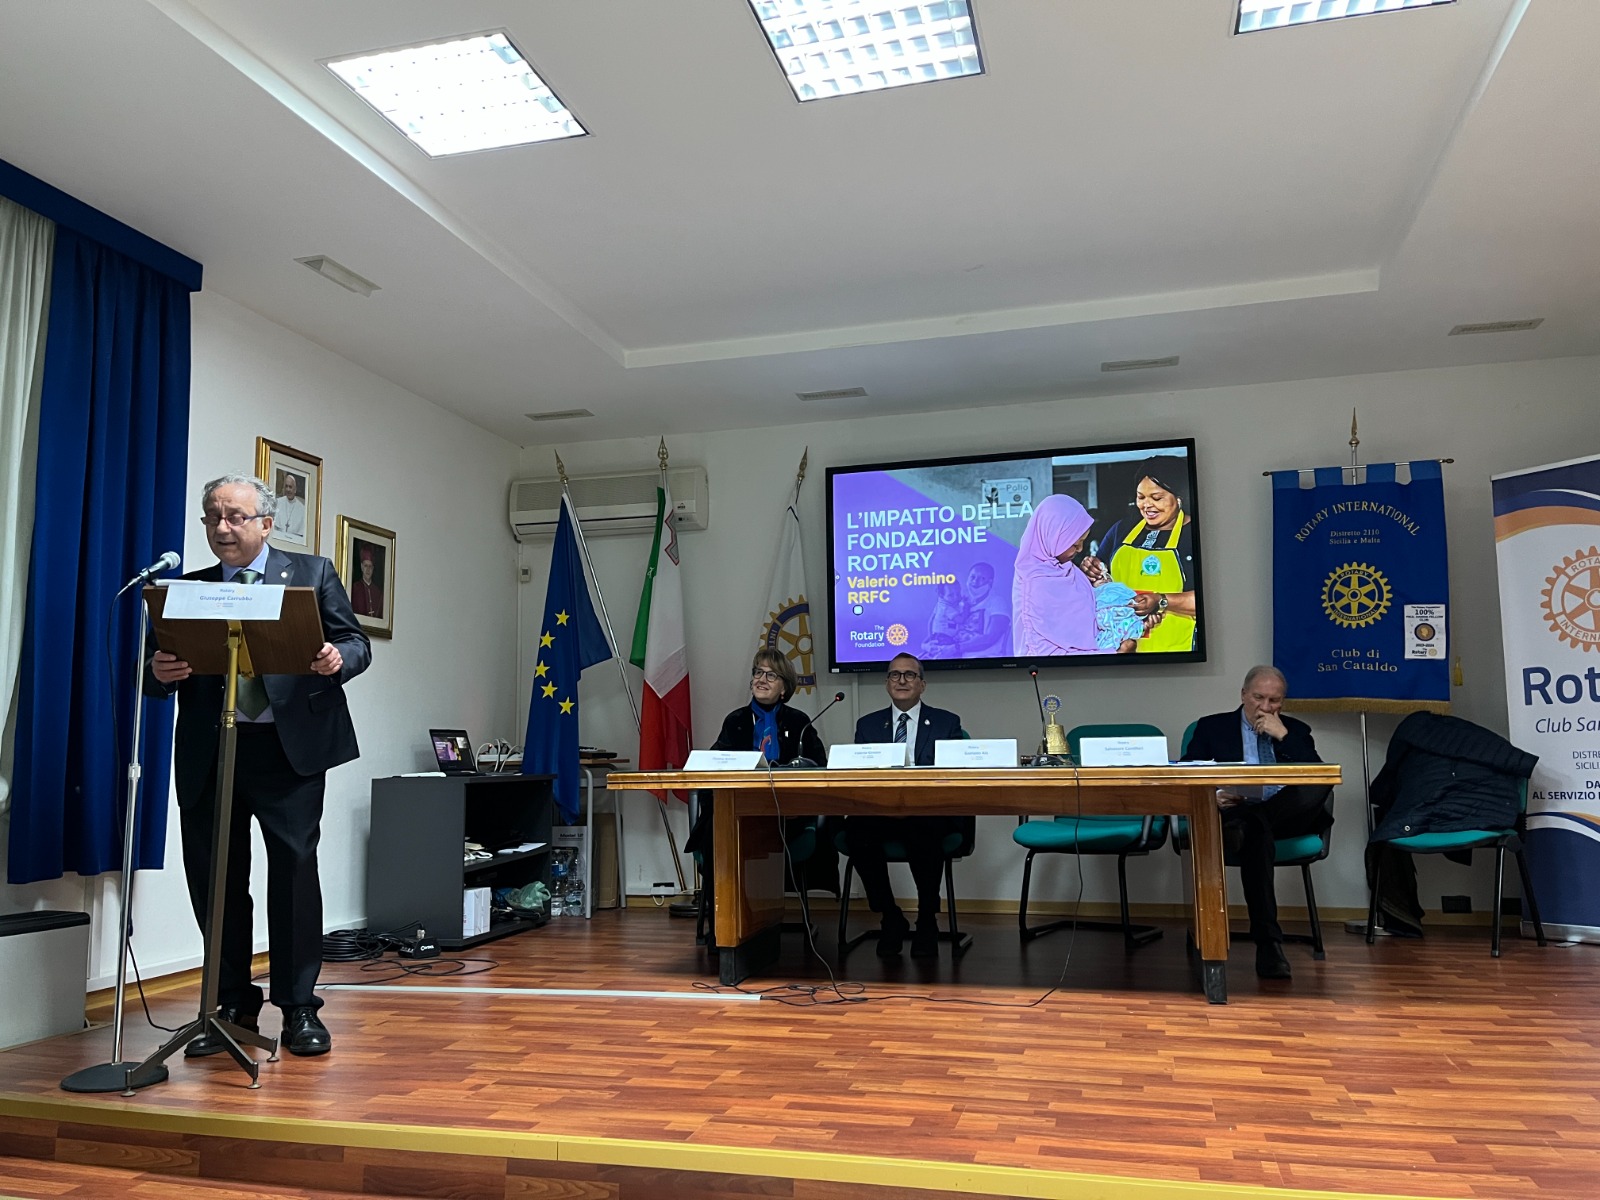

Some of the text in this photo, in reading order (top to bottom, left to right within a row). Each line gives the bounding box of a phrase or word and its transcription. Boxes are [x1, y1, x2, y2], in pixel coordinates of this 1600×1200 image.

[962, 500, 1034, 522] DELLA
[1294, 500, 1420, 542] ROTARY INTERNATIONAL
[847, 525, 988, 551] FONDAZIONE
[847, 551, 934, 572] ROTARY
[847, 572, 956, 589] Valerio Cimino
[847, 589, 890, 604] RRFC
[1333, 608, 1378, 621] INTERNATIONAL
[850, 631, 885, 641] Rotary
[1331, 648, 1380, 658] Club di
[1317, 660, 1398, 672] San Cataldo
[1522, 666, 1600, 706] Rot
[1535, 716, 1600, 733] Club Sa
[1532, 791, 1546, 800] AL
[1547, 791, 1596, 800] SERVIZIO
